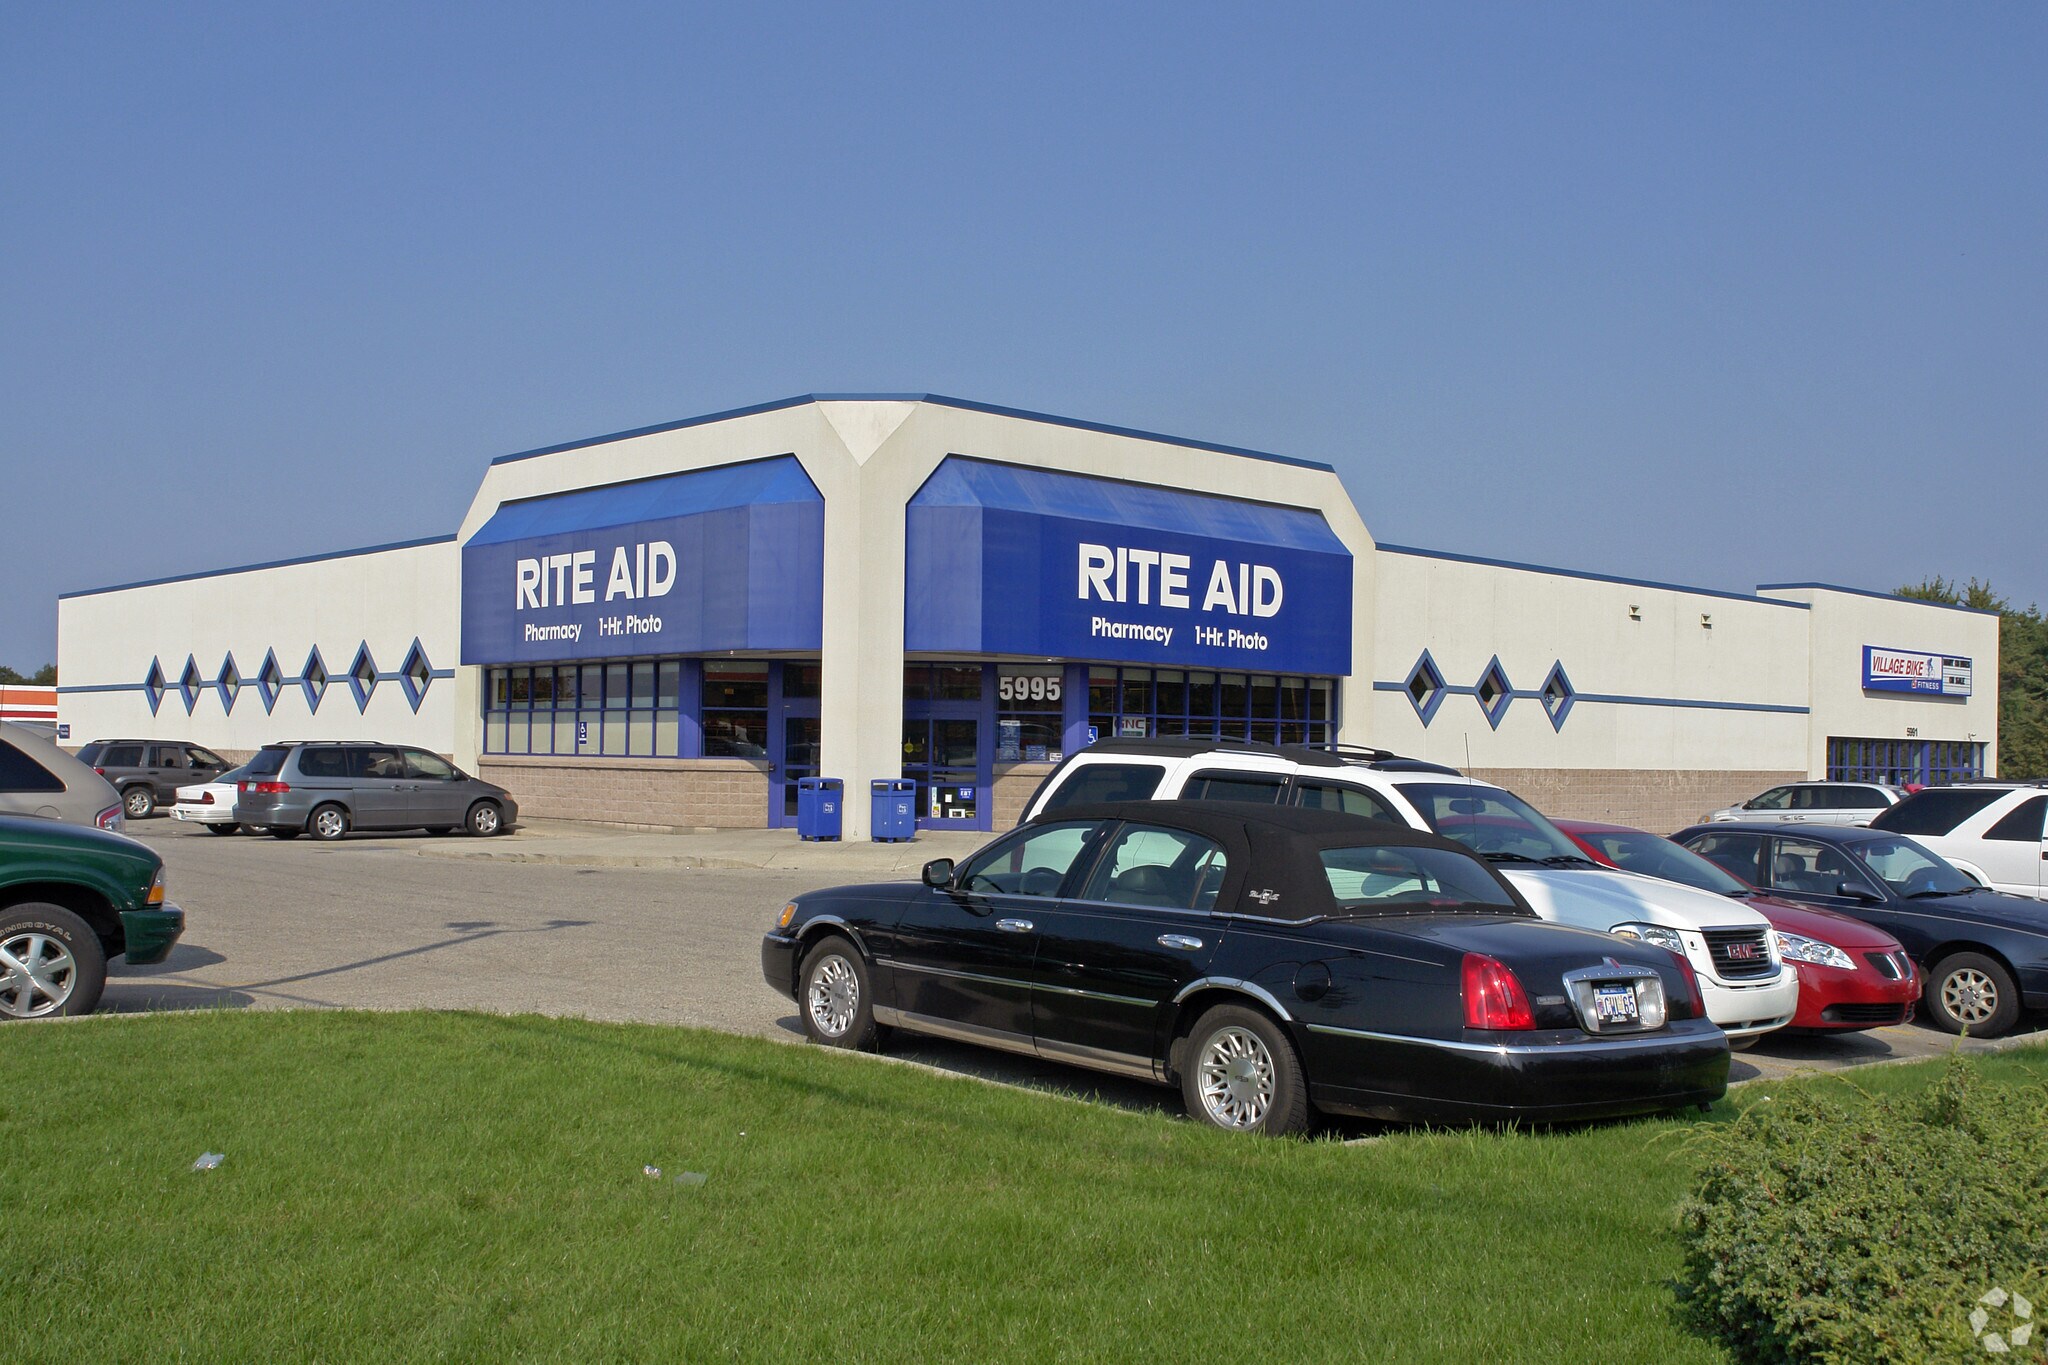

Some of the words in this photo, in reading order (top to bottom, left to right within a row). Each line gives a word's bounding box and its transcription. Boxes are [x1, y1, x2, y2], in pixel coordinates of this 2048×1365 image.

[516, 551, 595, 610] RITE
[605, 541, 677, 602] AID
[1078, 543, 1190, 609] RITE
[1202, 560, 1283, 618] AID
[525, 623, 582, 642] Pharmacy
[598, 617, 623, 636] 1-Hr.
[626, 614, 661, 635] Photo
[1091, 617, 1173, 646] Pharmacy
[1195, 626, 1225, 647] 1-Hr.
[1228, 629, 1268, 650] Photo
[1873, 656, 1905, 674] VILLAGE
[1905, 660, 1924, 676] BIKE
[999, 676, 1061, 701] 5995
[1917, 681, 1939, 690] FITNESS
[1727, 944, 1759, 959] GMC
